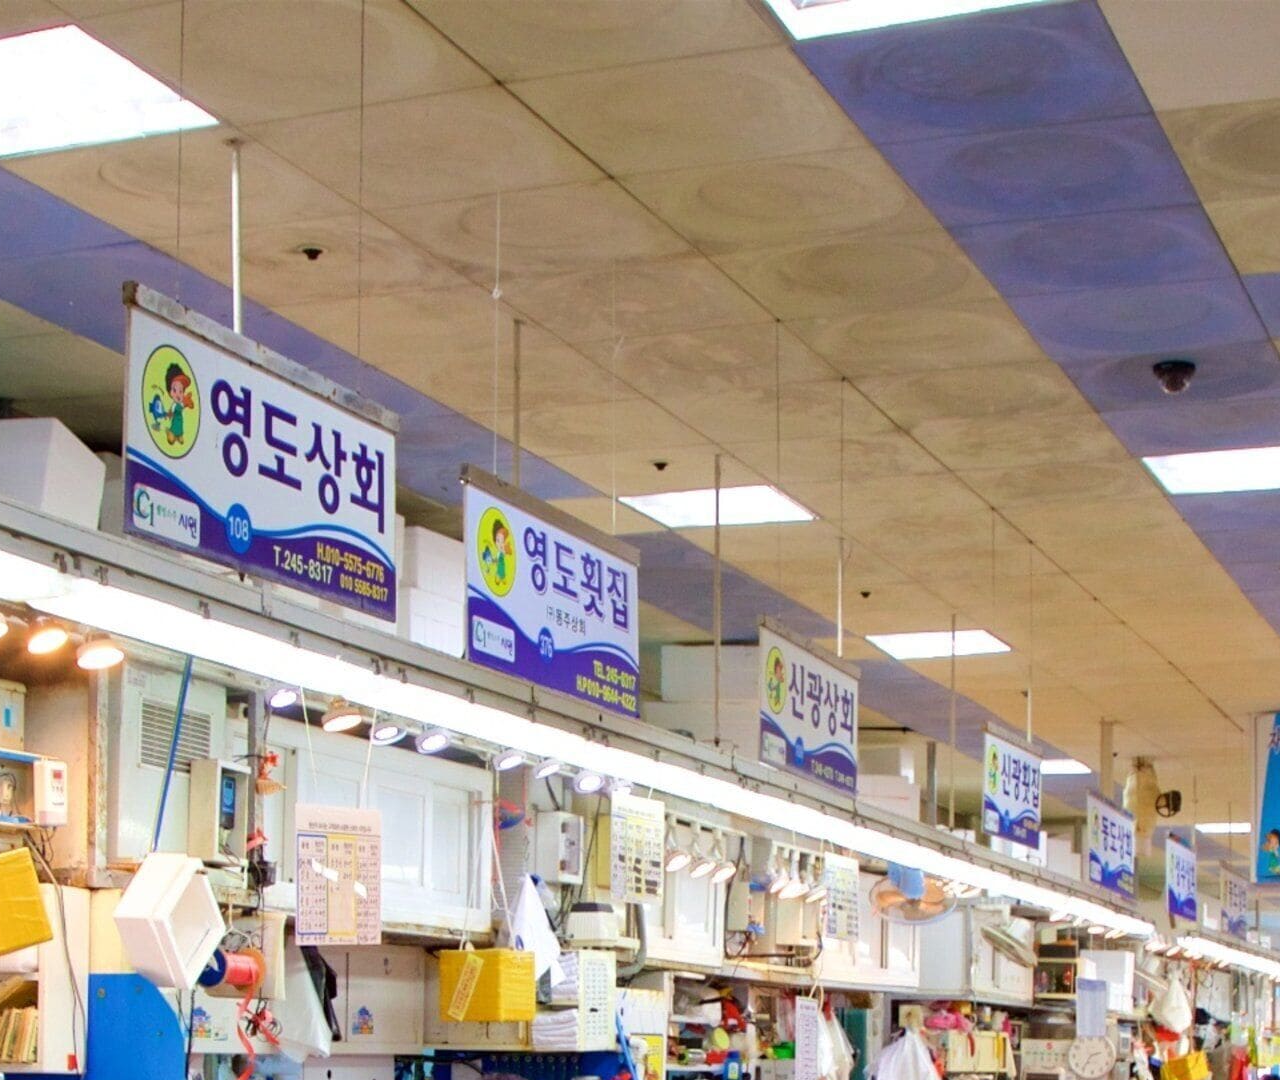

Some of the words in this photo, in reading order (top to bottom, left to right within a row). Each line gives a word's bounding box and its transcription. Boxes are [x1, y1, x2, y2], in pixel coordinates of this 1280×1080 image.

[210, 378, 386, 534] 영도상회
[228, 514, 249, 542] 108
[273, 546, 333, 585] T.245-8317
[523, 526, 629, 630] 영도횟집
[788, 662, 855, 745] 신광상회
